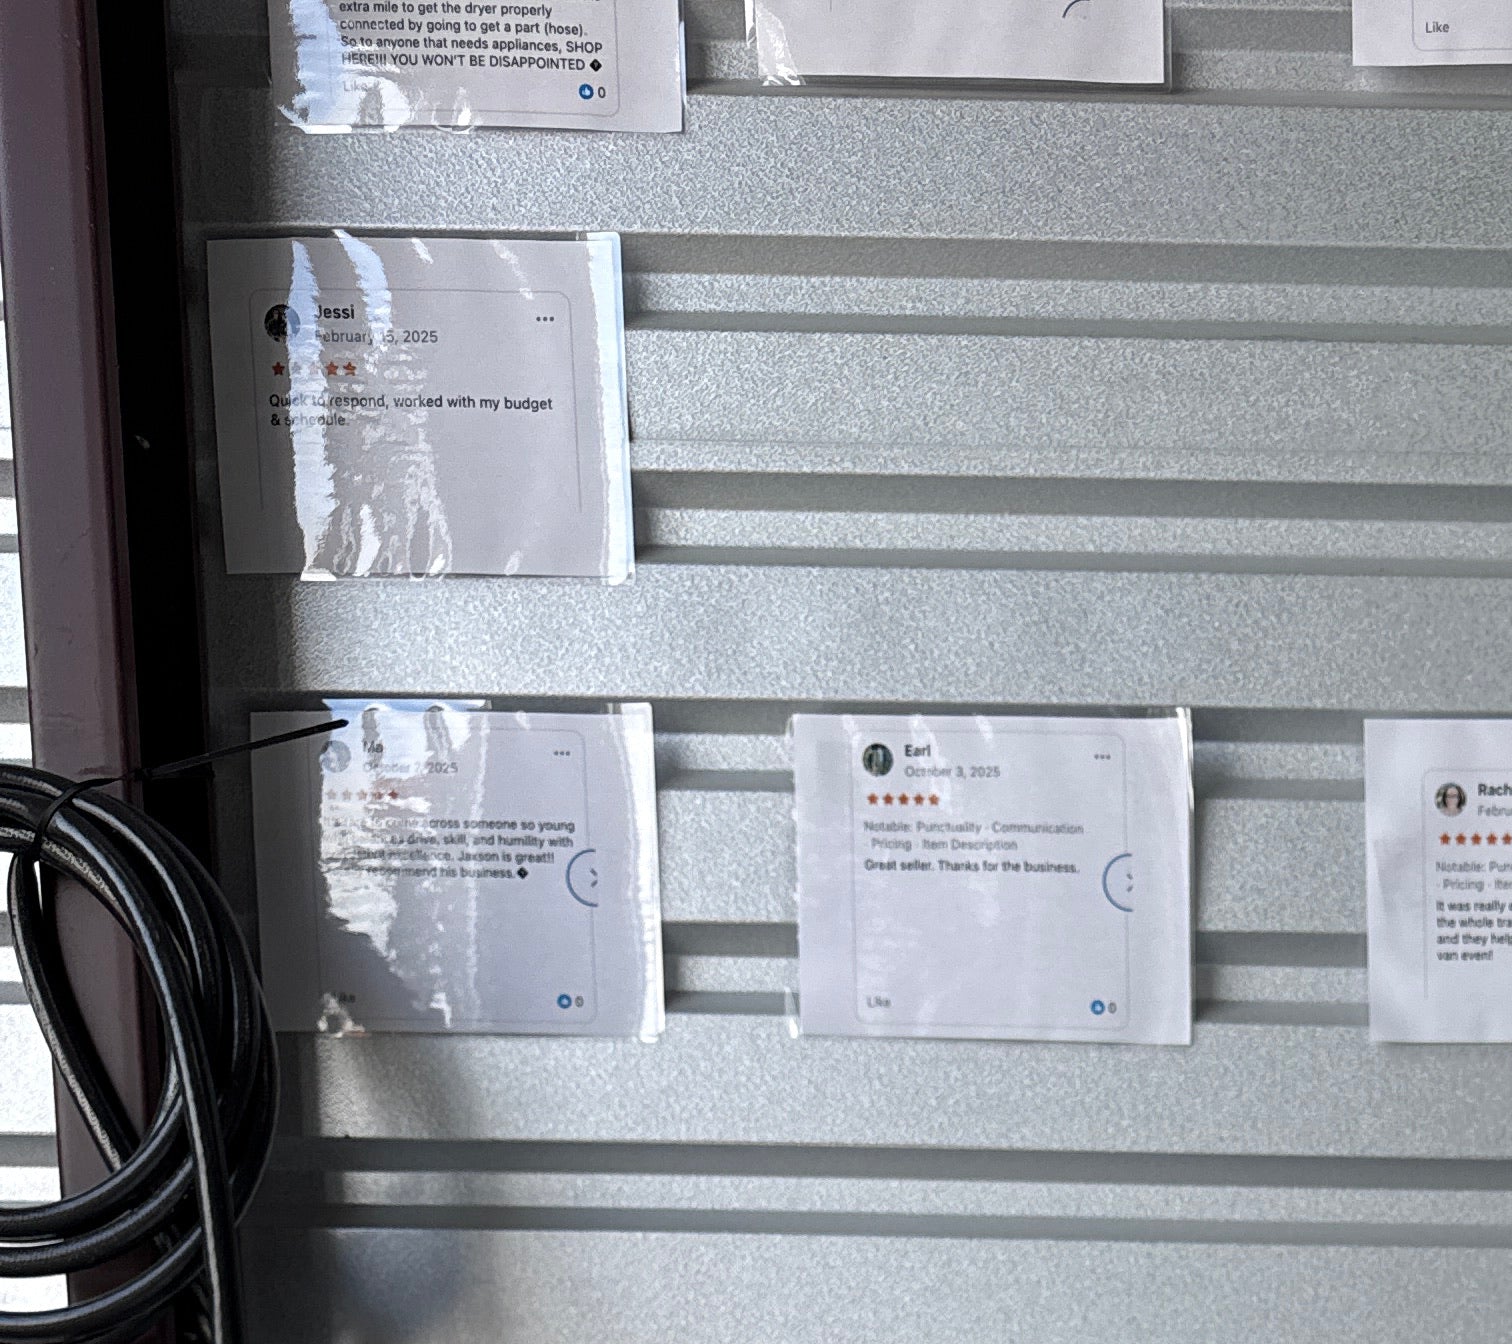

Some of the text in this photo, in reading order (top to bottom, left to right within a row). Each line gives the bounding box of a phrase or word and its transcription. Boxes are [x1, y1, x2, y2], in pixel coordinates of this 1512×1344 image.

[339, 1, 553, 18] extra mile to get the dryer properly
[340, 19, 589, 37] connected by going to get a part (hose).
[1425, 21, 1450, 34] Like
[377, 38, 420, 52] anyone
[424, 37, 447, 50] that
[451, 38, 489, 50] needs
[492, 39, 563, 54] appliances,
[566, 41, 603, 54] SHOP
[392, 54, 418, 66] YOU
[422, 54, 465, 67] WON'T
[470, 56, 486, 67] BE
[490, 56, 586, 71] DISAPPOINTED
[598, 86, 606, 98] 0
[317, 304, 355, 320] Jessi
[402, 330, 439, 344] 2025
[330, 394, 388, 410] respond,
[393, 395, 444, 409] worked
[447, 396, 477, 409] with
[480, 399, 501, 412] my
[504, 397, 553, 412] budget
[270, 413, 282, 427] &
[904, 766, 952, 779] October
[970, 766, 1001, 778] 2025
[916, 821, 983, 835] Punctuality
[991, 822, 1084, 835] Communication
[871, 839, 913, 852] Pricing
[951, 839, 1019, 852] Description
[864, 859, 898, 871] Great
[938, 860, 980, 872] Thanks
[983, 860, 999, 872] for
[1002, 860, 1022, 872] the
[1443, 879, 1485, 892] Pricing
[1462, 933, 1489, 946] they
